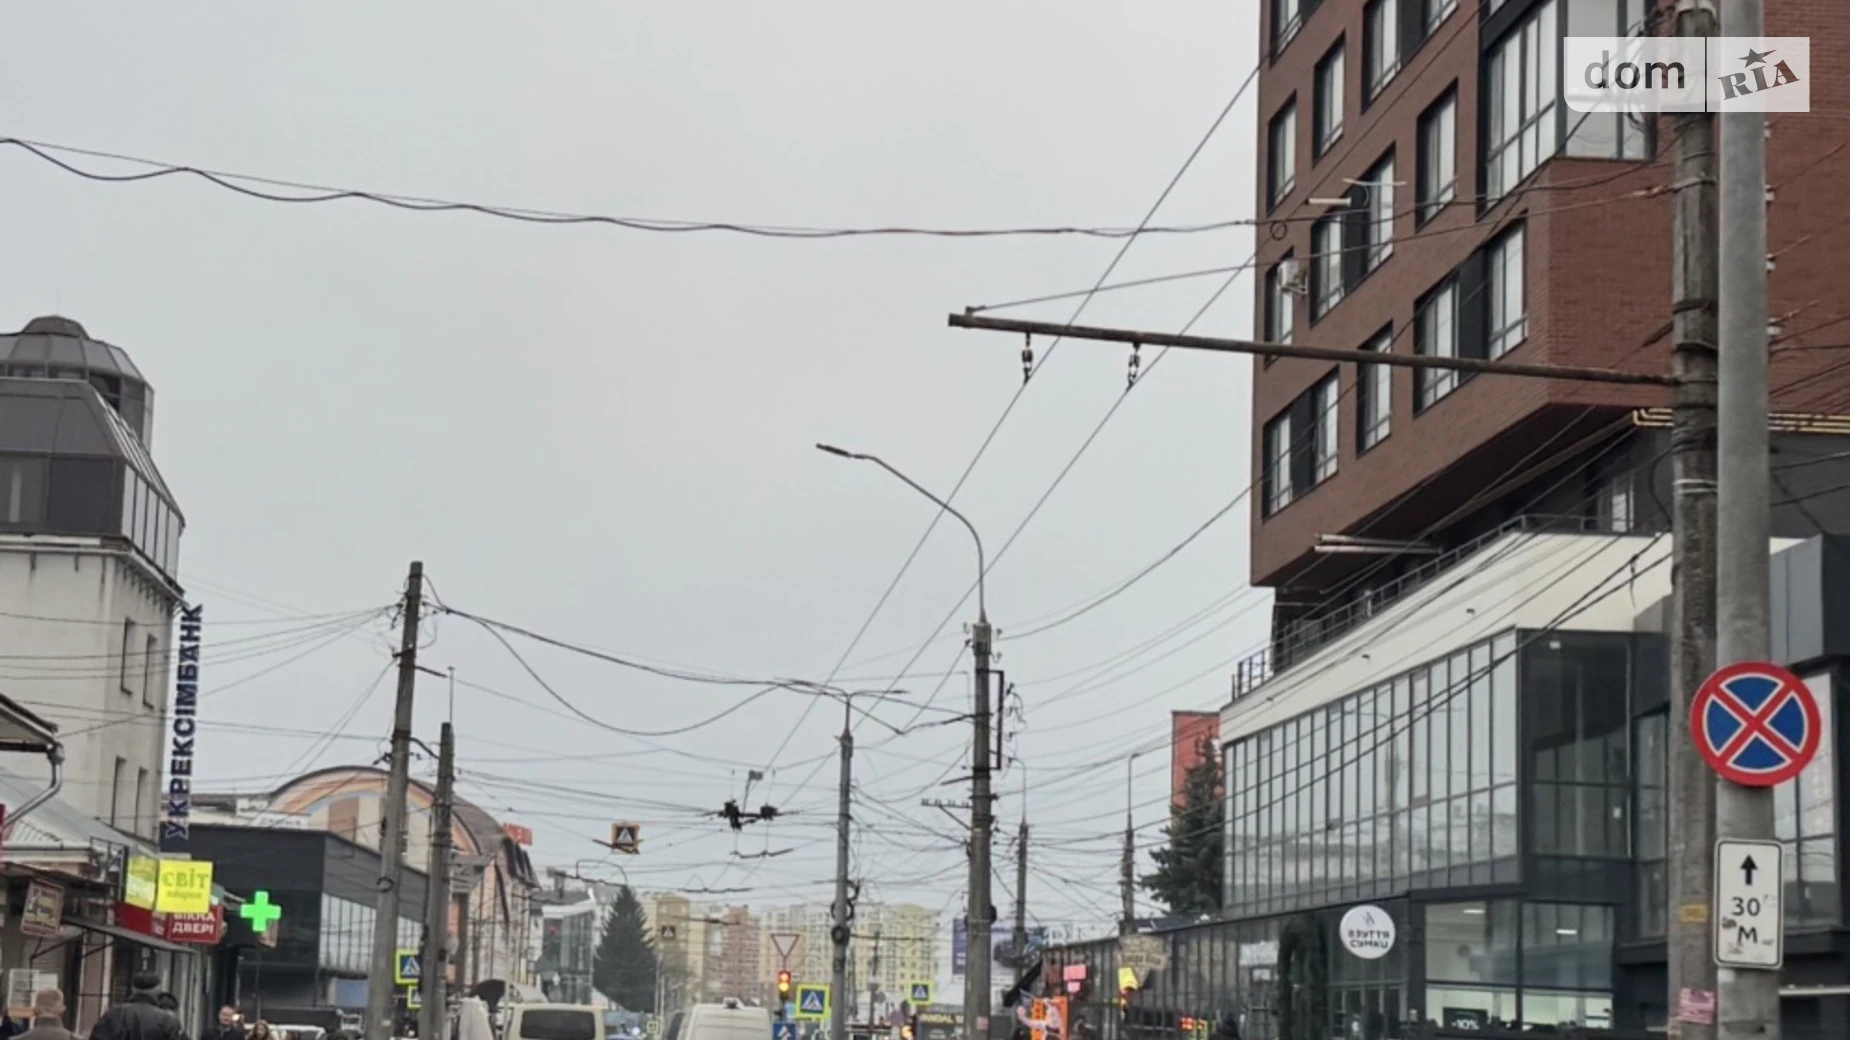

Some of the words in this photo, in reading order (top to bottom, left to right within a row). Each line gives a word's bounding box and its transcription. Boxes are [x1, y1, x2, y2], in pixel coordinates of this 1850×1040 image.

[165, 603, 203, 840] УКРЕКСІМБАНК
[1731, 896, 1761, 916] 30
[172, 922, 215, 935] ДВЕРІ
[1347, 929, 1390, 939] ВЗУТТЯ
